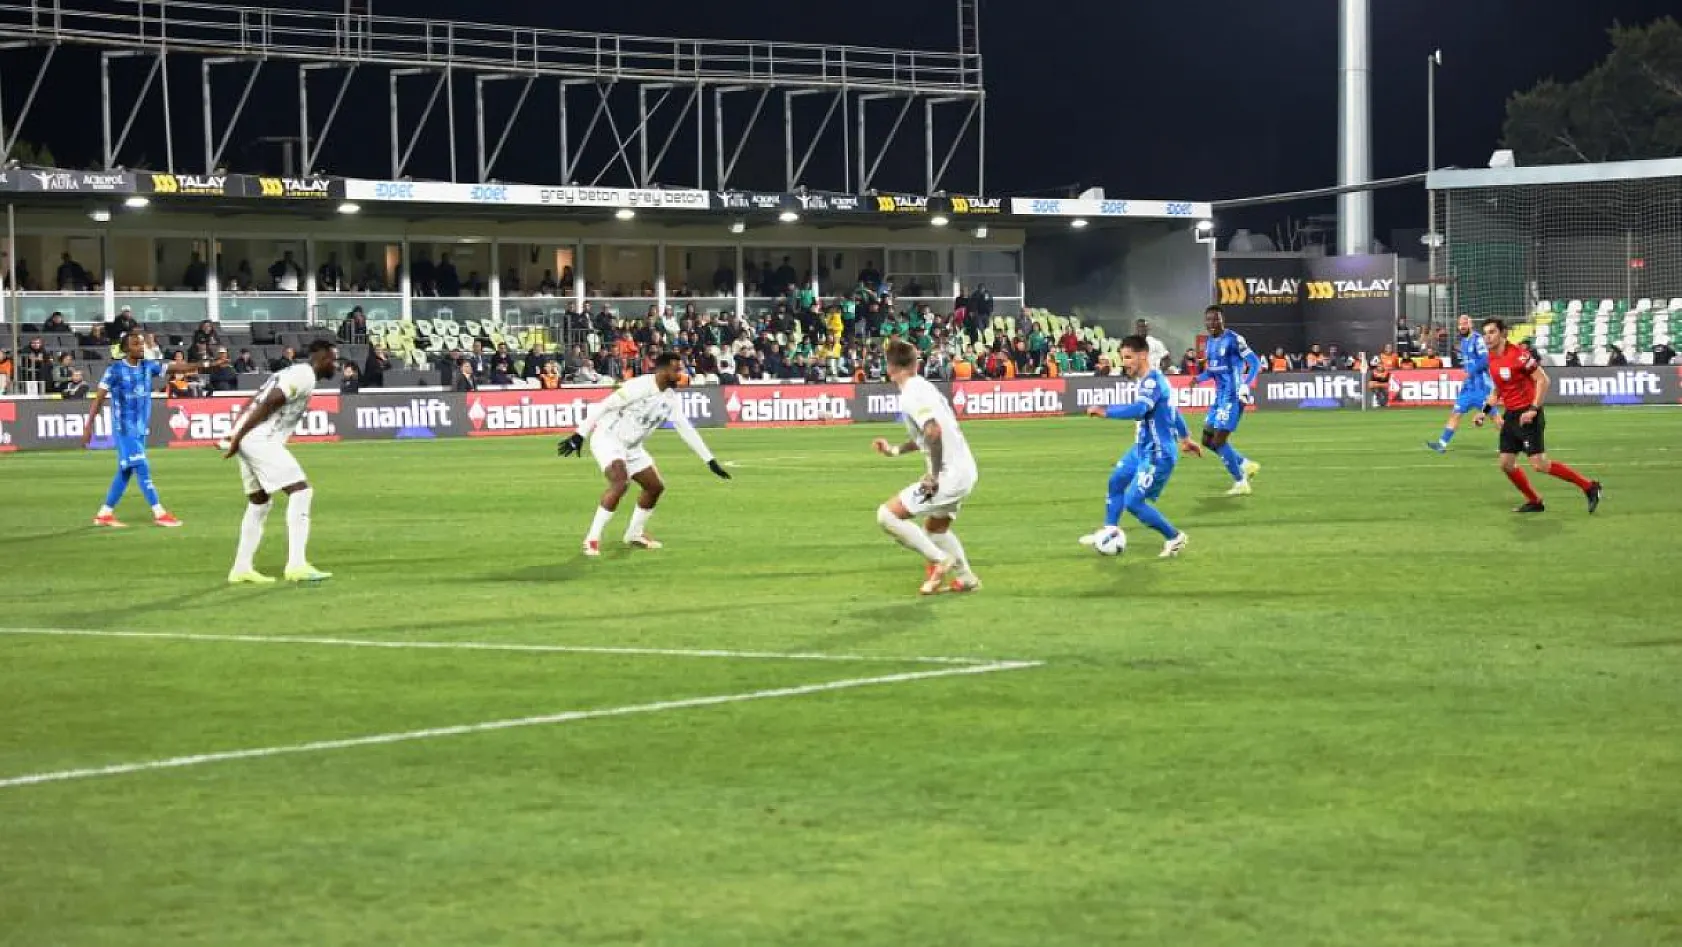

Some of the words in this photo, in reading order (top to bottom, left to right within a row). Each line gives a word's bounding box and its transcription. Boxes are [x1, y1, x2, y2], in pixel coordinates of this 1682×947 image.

[175, 174, 228, 187] TALAY
[281, 177, 330, 191] TALAY
[540, 189, 574, 203] grey
[578, 190, 620, 201] beton
[628, 191, 660, 206] grey
[665, 192, 704, 204] beton
[893, 196, 928, 207] TALAY
[968, 198, 1001, 208] TALAY
[1245, 277, 1301, 295] TALAY
[1333, 278, 1392, 291] TALAY
[1267, 375, 1362, 399] manlift
[1559, 371, 1661, 395] manlift
[741, 391, 851, 422] asimato.
[967, 386, 1063, 415] asimato.
[356, 399, 452, 428] manlift
